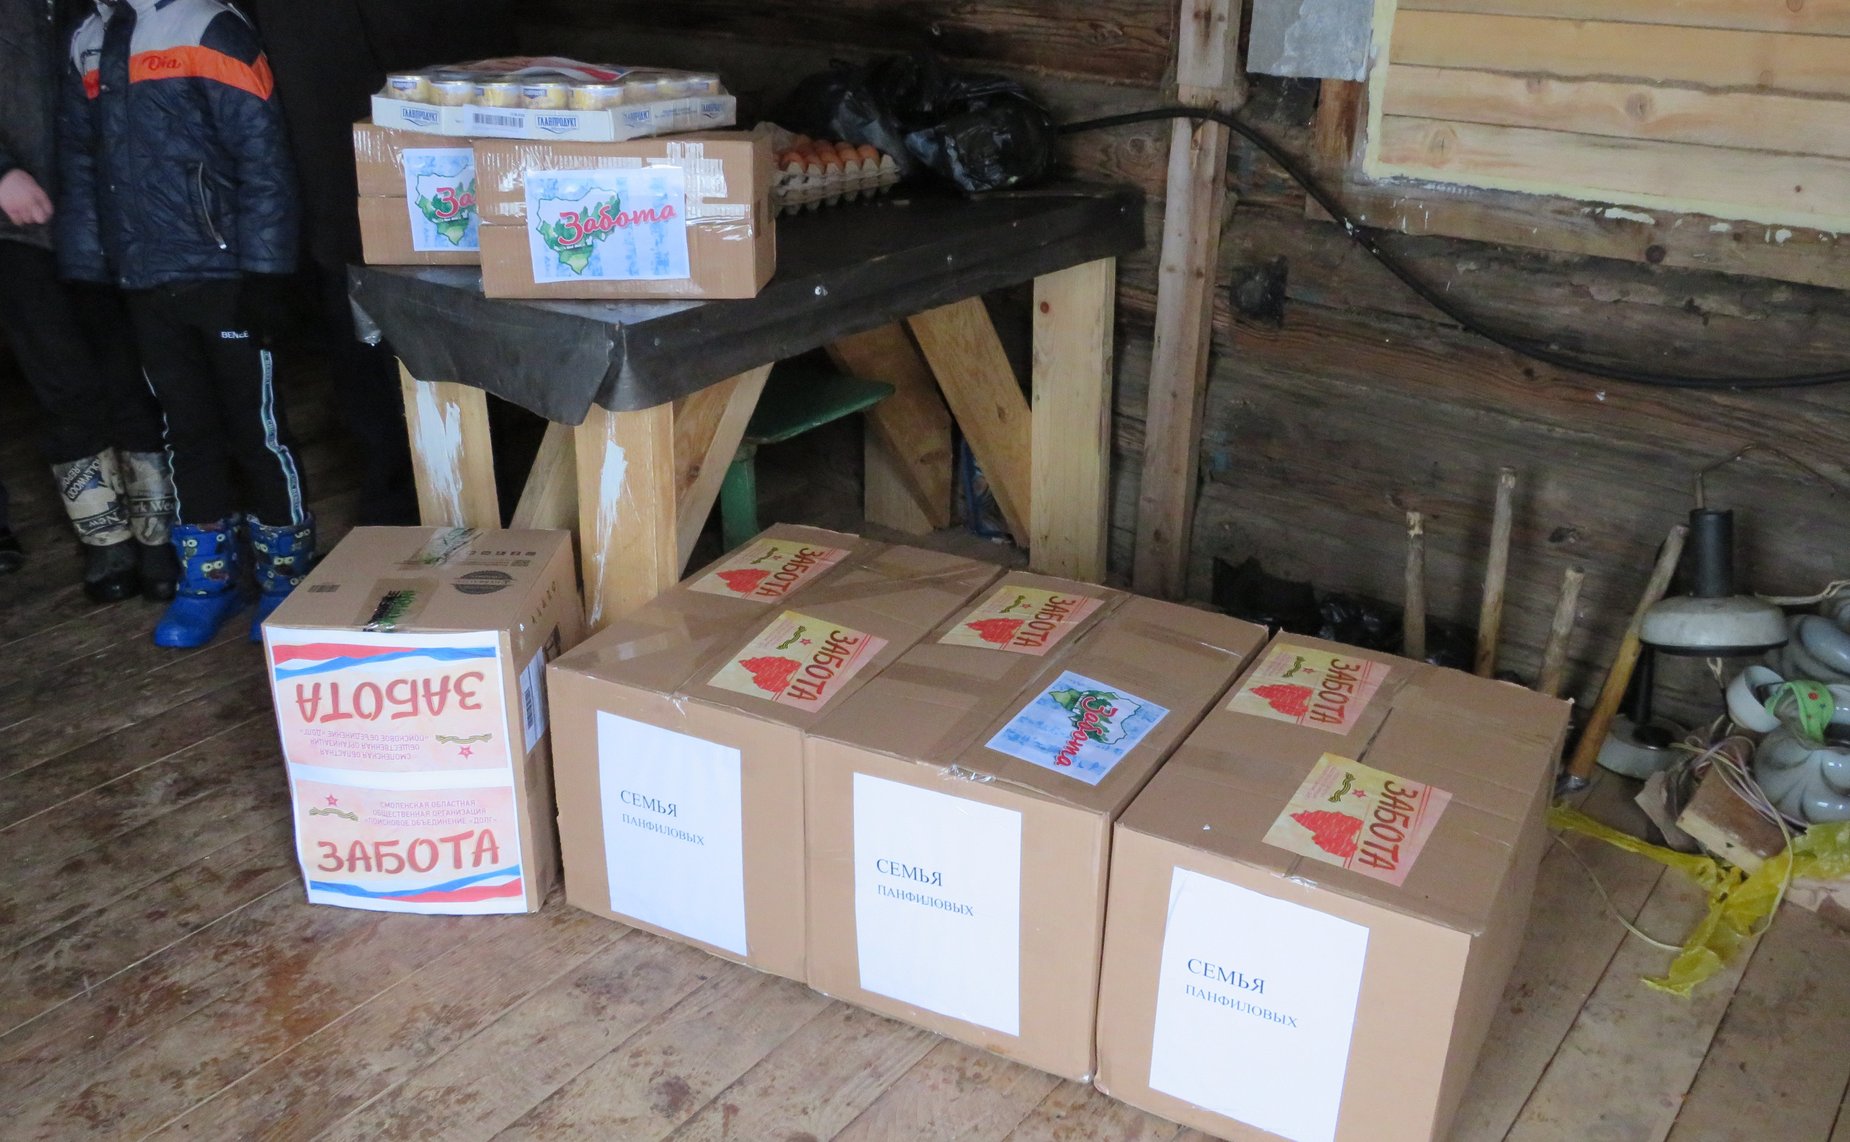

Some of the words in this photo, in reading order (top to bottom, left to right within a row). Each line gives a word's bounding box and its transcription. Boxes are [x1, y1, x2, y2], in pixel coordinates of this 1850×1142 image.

[537, 116, 577, 128] ГЛАВПРОДУКТ
[557, 203, 677, 245] Забота
[66, 457, 101, 499] OLLYWOOD
[755, 547, 825, 597] ЗАБОТА
[1013, 596, 1076, 647] ЗАБОТА
[786, 630, 860, 701] ЗАБОТА
[295, 671, 485, 723] ЗАБОТА
[1309, 658, 1361, 726] ЗАБОТА
[1054, 696, 1118, 767] Забота
[380, 801, 430, 809] СМОЛЕНСКАЯ
[431, 800, 476, 808] ОБЛАСТНАЯ
[620, 789, 678, 818] СЕМЬЯ
[621, 812, 705, 847] ПАНФИЛОВЫХ
[1358, 779, 1419, 872] ЗАБОТА
[317, 828, 501, 875] ЗАБОТА
[876, 858, 943, 888] СЕМЬЯ
[877, 884, 975, 918] ПАНФИЛОВЫХ
[1187, 957, 1266, 995] СЕМЬЯ
[1185, 983, 1298, 1028] ПАНФИЛОВЫХ
